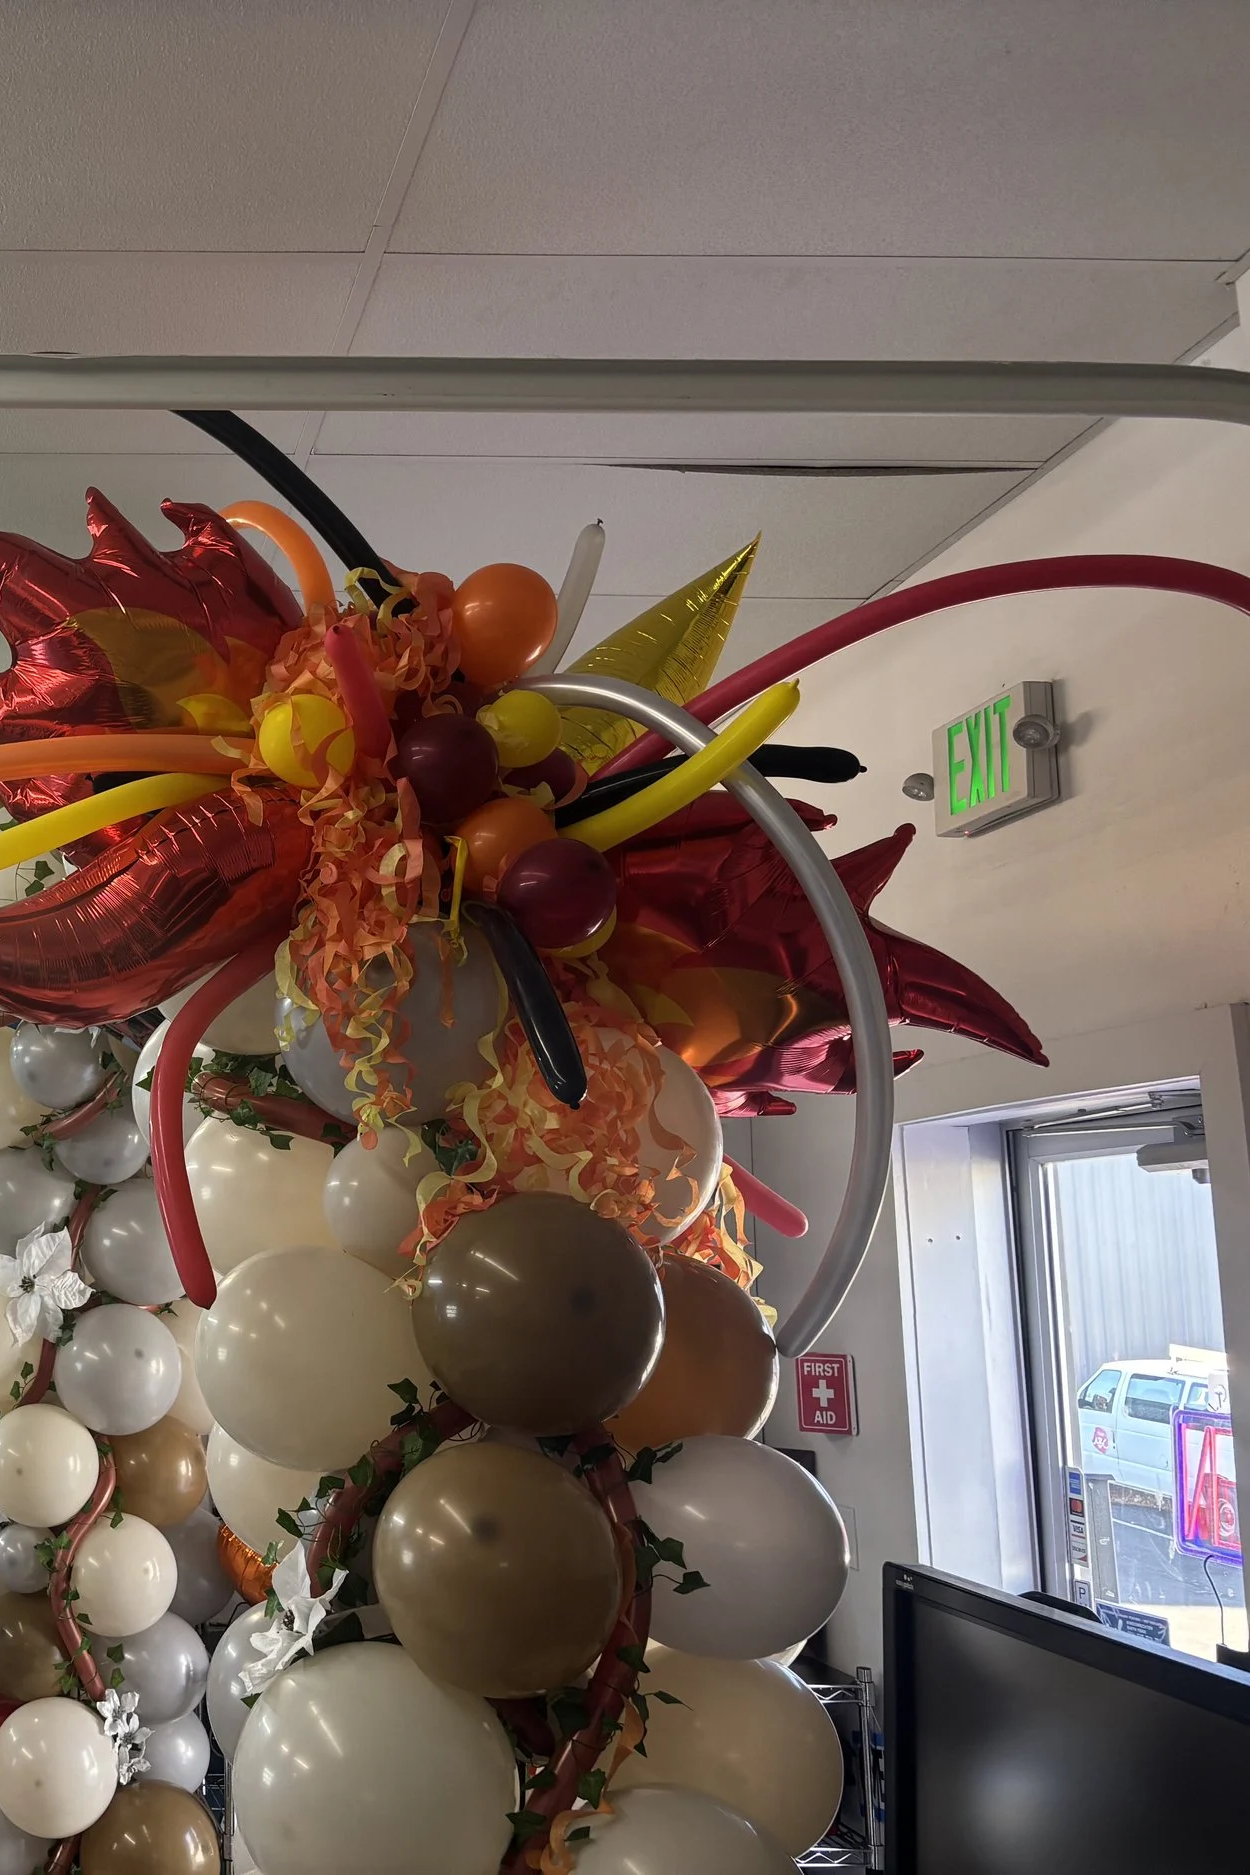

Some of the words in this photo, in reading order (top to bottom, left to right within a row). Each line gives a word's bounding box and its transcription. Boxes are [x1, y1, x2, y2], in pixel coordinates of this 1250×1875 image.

[947, 694, 1011, 816] EXIT
[803, 1362, 840, 1377] FIRST
[814, 1410, 836, 1424] AID
[1072, 1524, 1084, 1534] VISA
